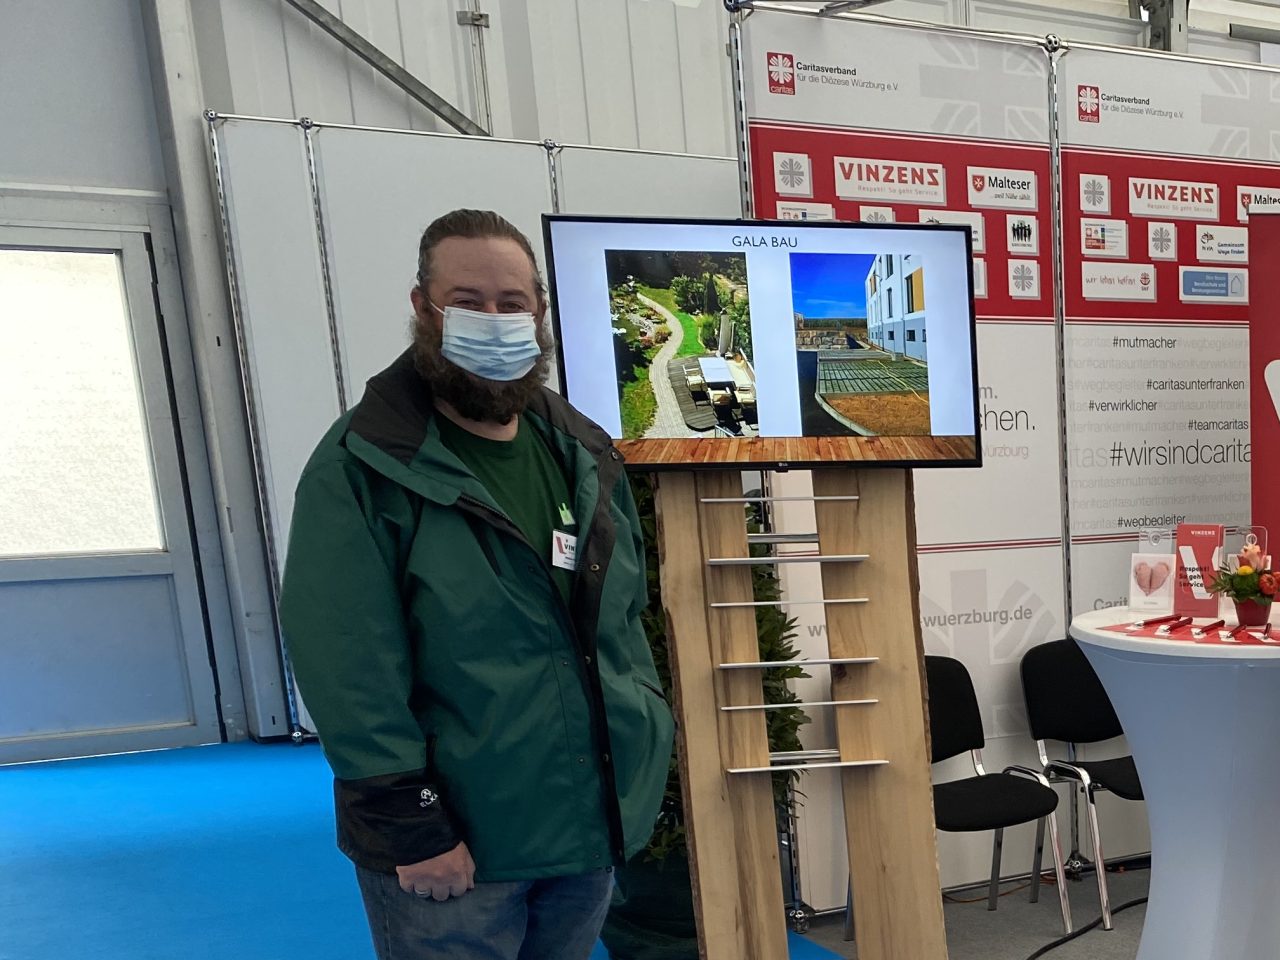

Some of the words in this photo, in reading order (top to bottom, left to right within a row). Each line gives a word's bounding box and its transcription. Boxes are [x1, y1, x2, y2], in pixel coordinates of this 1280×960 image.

[796, 61, 857, 76] Caritasverband
[796, 73, 807, 82] für
[808, 74, 819, 84] die
[820, 75, 849, 86] Diözese
[851, 78, 886, 91] Würzburg
[1101, 93, 1150, 106] Caritasverband
[988, 176, 1031, 190] Malteser
[731, 236, 767, 248] GALA
[772, 236, 798, 248] BAU
[1113, 335, 1177, 349] #mutmacher
[1147, 377, 1244, 390] #caritasunterfranken
[1088, 399, 1157, 412] #verwirklicher
[1188, 419, 1249, 431] #teamcaritas
